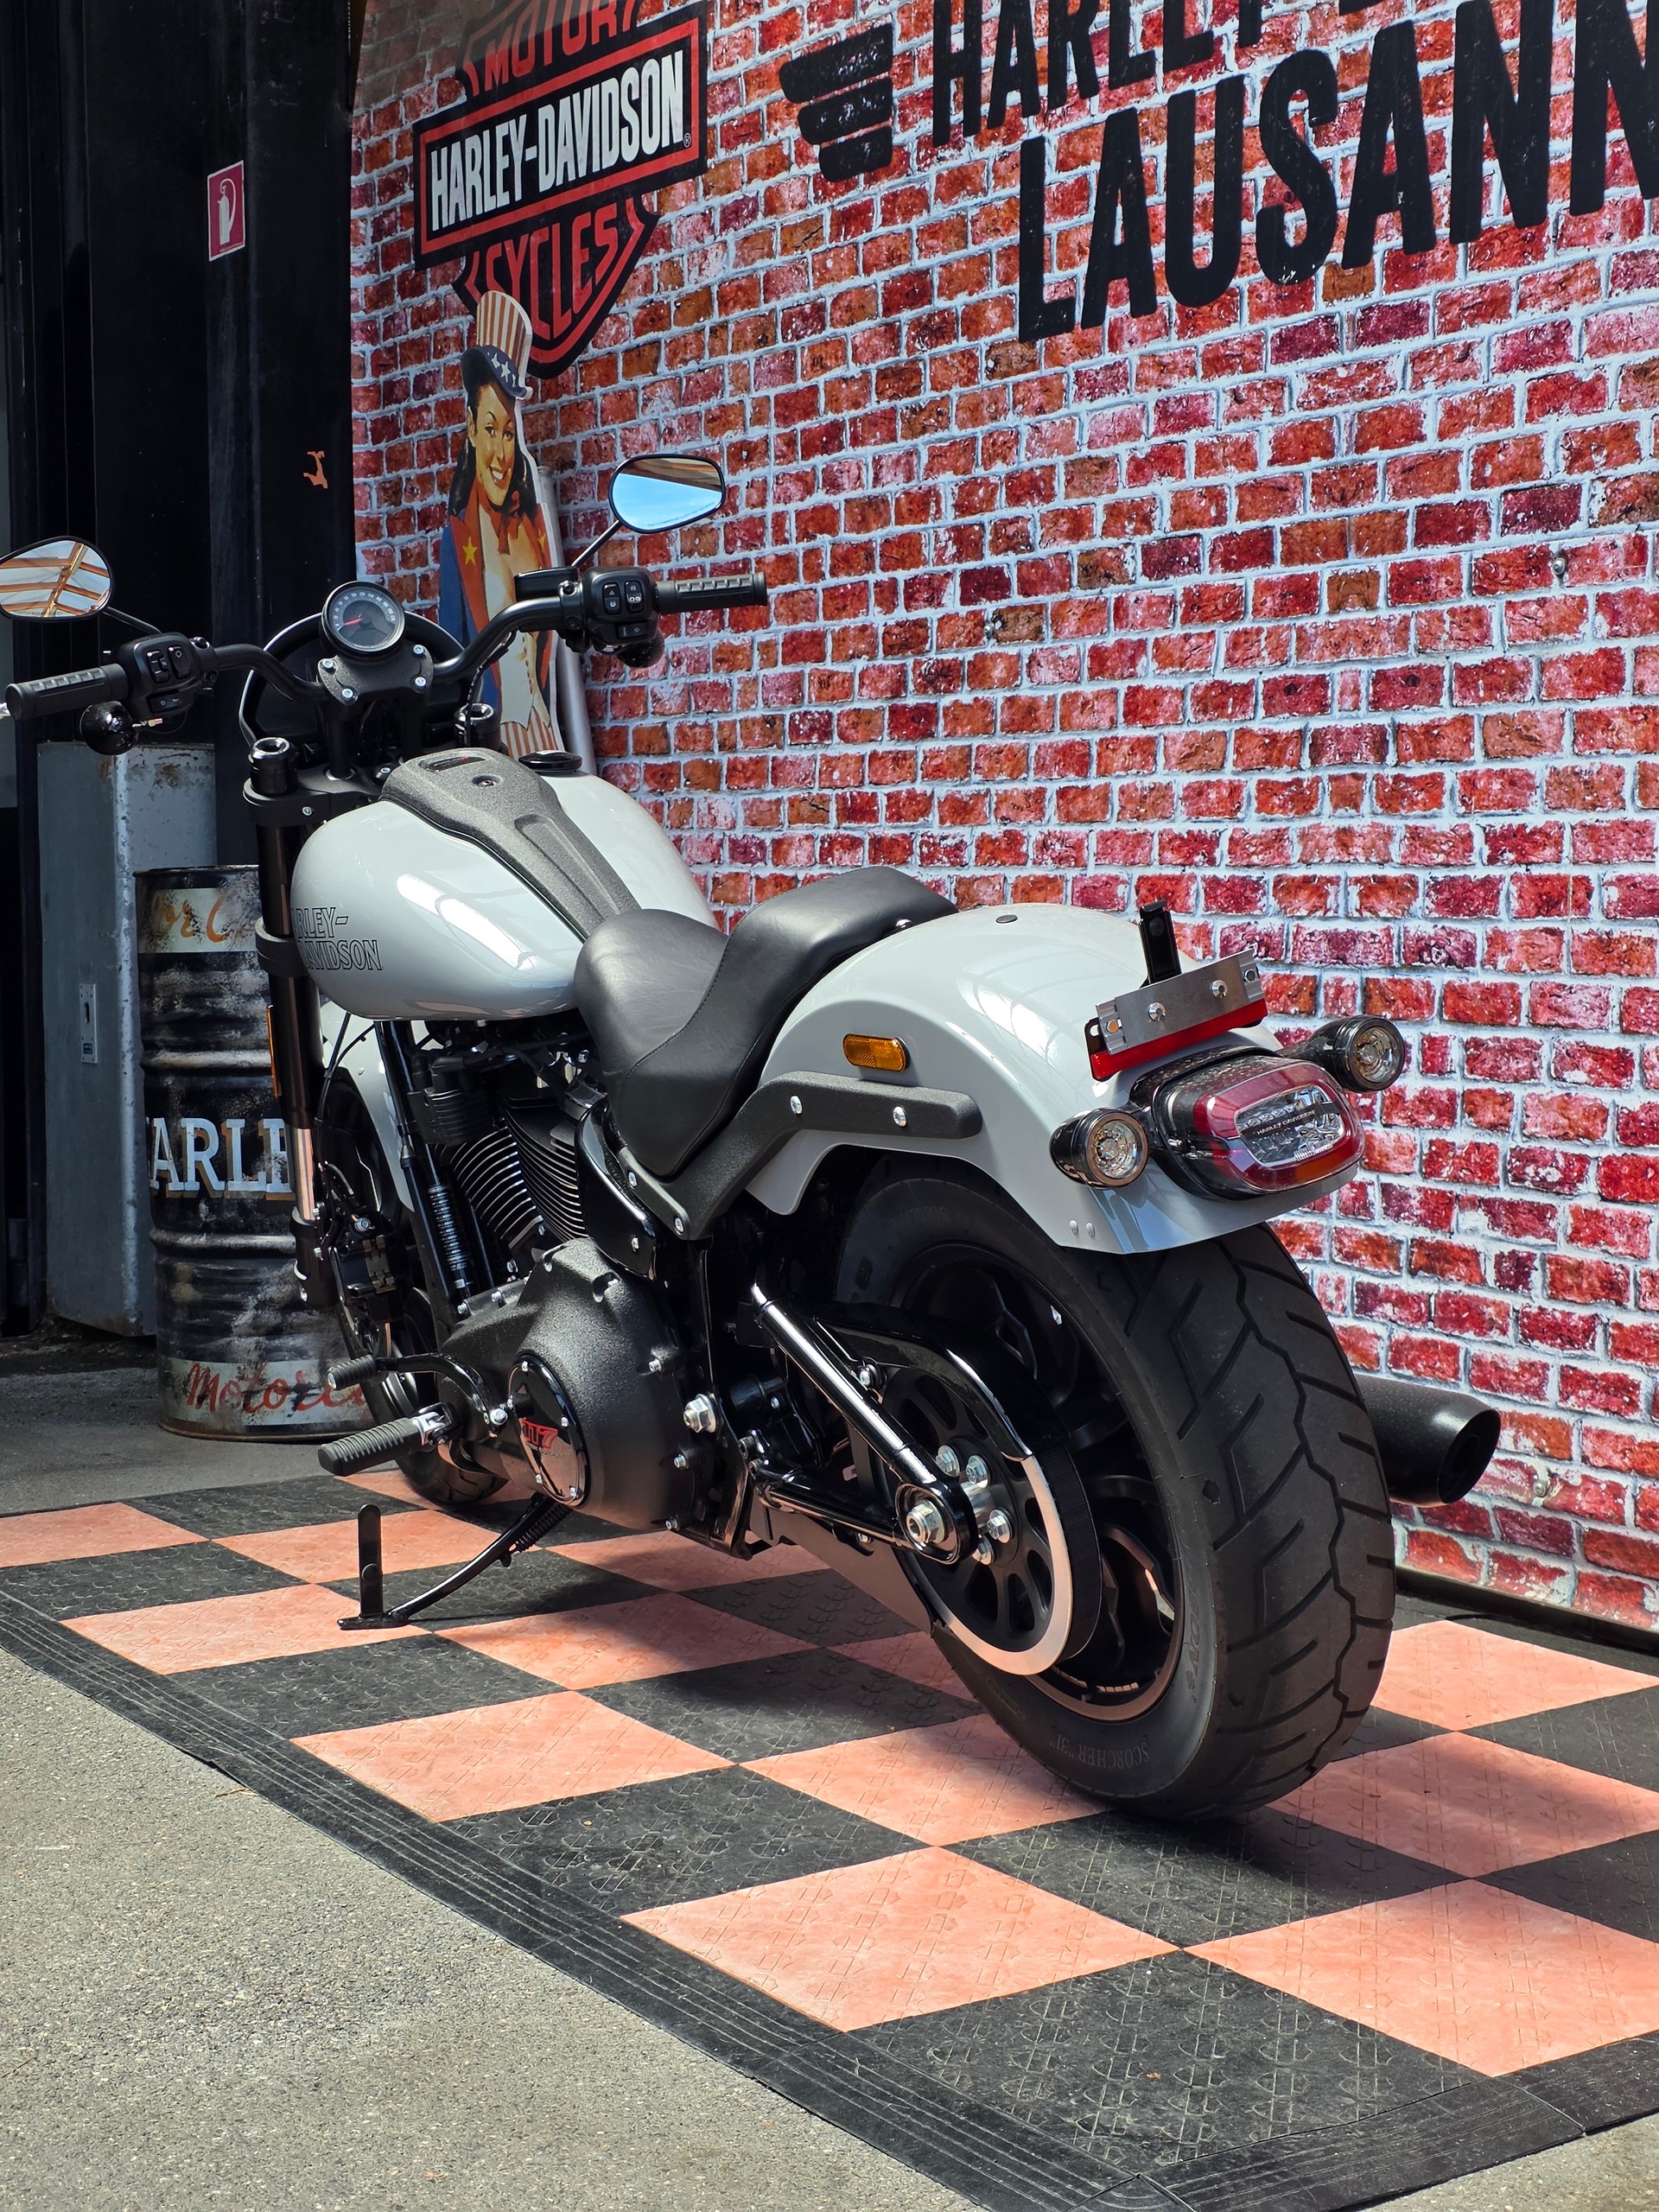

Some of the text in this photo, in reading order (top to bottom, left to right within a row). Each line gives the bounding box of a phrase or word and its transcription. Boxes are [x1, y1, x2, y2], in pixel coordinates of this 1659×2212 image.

[431, 49, 683, 232] HARLEY-DAVIDSON
[486, 202, 619, 340] CYCLES
[1078, 1741, 1149, 1770] SCORCHER
